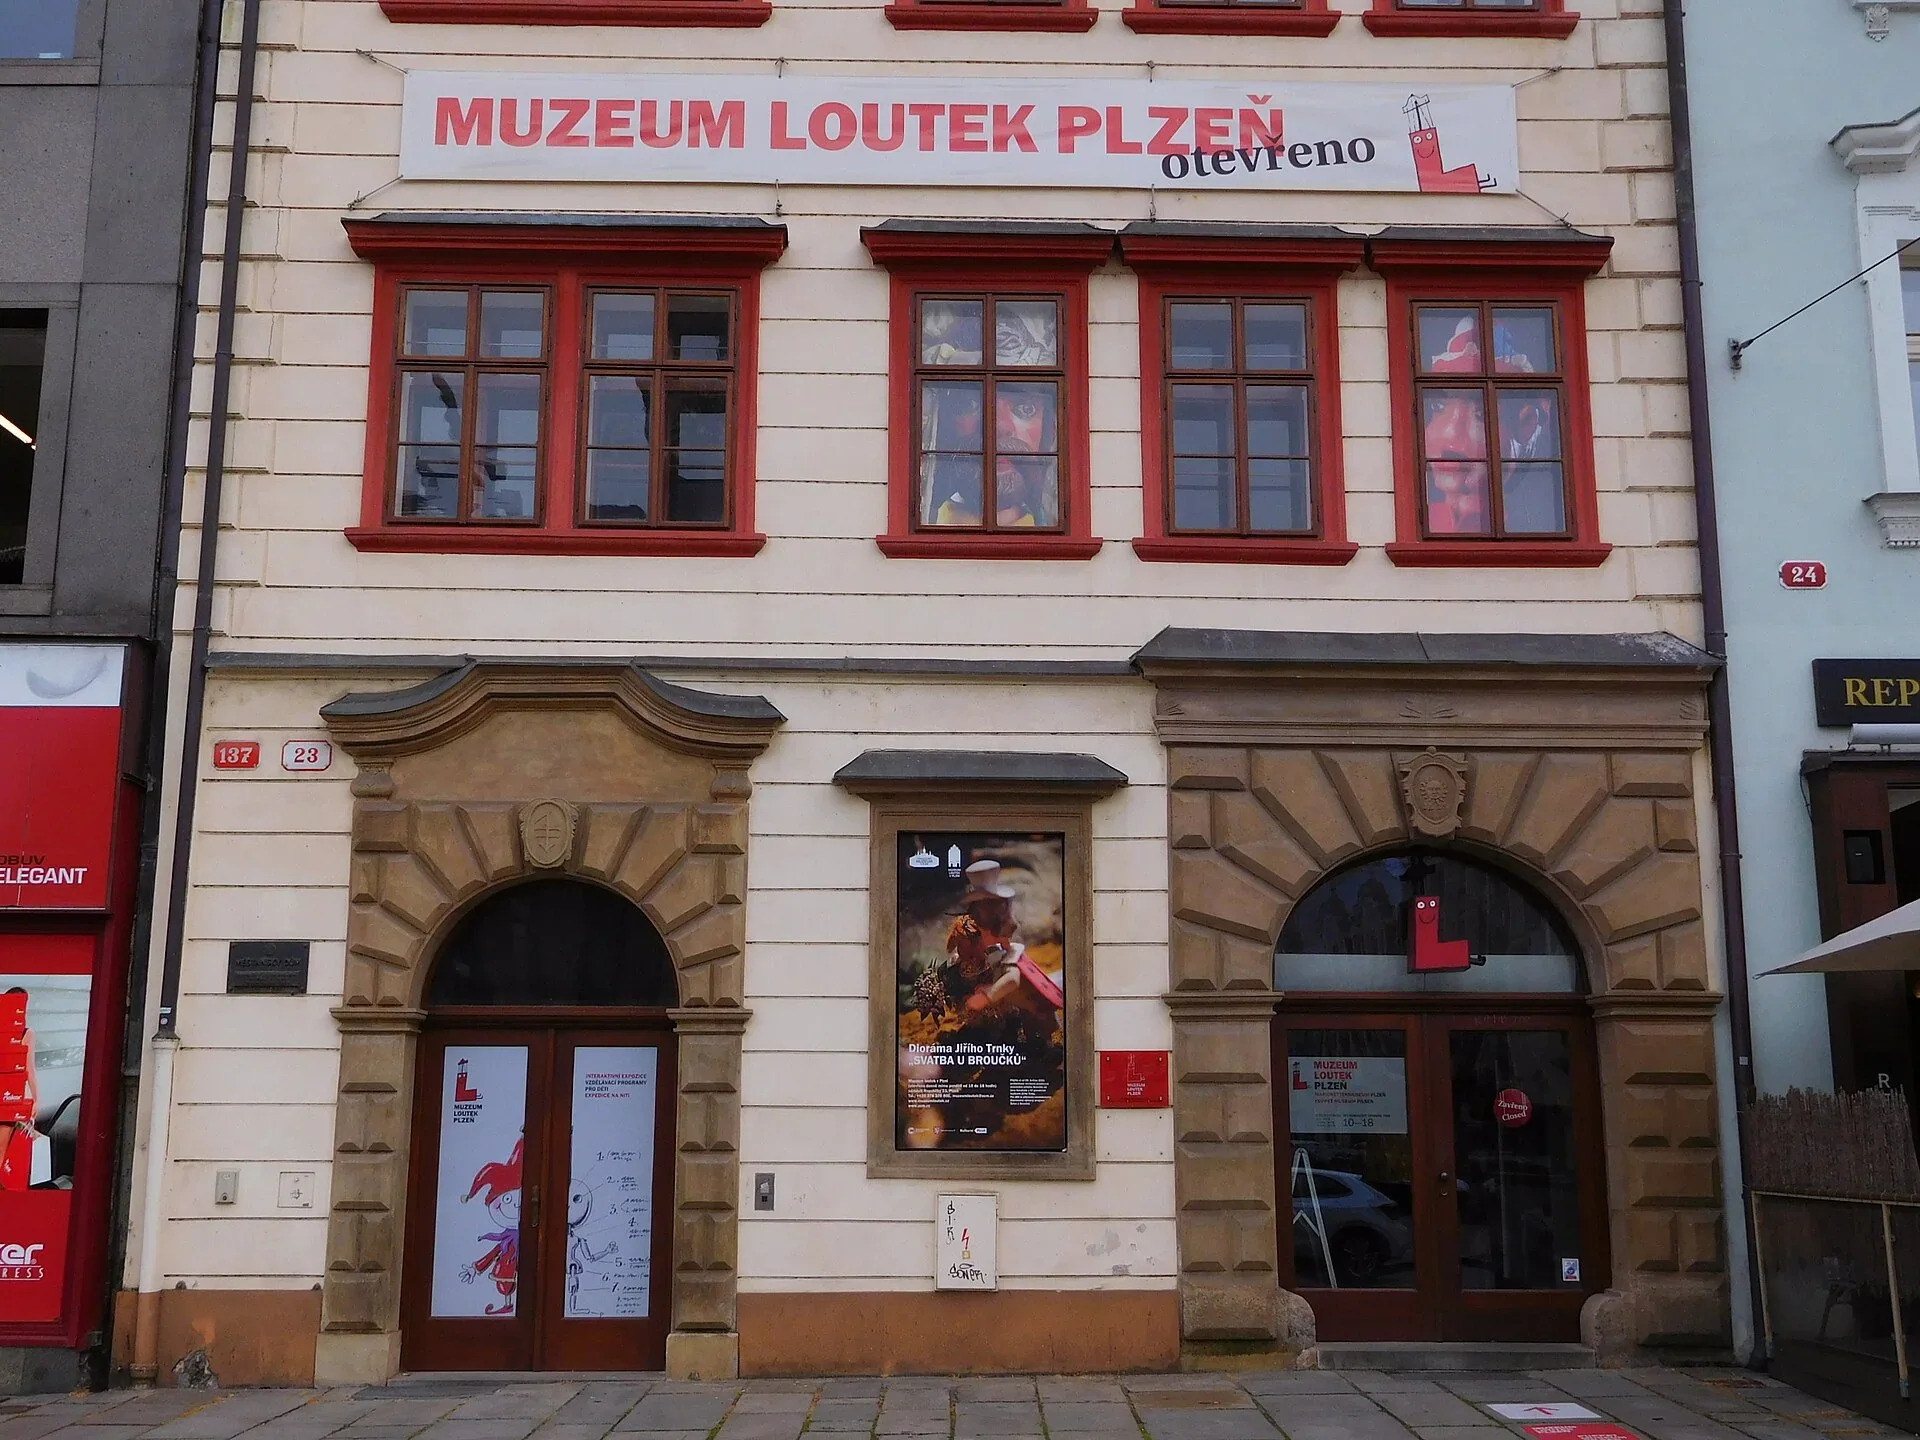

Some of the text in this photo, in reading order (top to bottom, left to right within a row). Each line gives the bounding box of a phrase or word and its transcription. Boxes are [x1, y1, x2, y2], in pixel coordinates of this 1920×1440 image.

[434, 94, 1284, 156] MUZEUM LOUTEK PLZEŇ
[1160, 133, 1376, 180] otevřeno
[1791, 566, 1817, 583] 24
[1843, 678, 1920, 706] REP
[219, 746, 253, 764] 137
[294, 747, 319, 764] 23
[908, 1042, 1015, 1055] Dioráma Jiřího Trnky
[957, 1055, 965, 1066] U
[1313, 1061, 1358, 1070] MUZEUM
[1314, 1071, 1353, 1080] LOUTEK
[1314, 1080, 1348, 1090] PLZEŇ
[1498, 1099, 1528, 1111] Zavřeno
[1502, 1111, 1527, 1121] Closed
